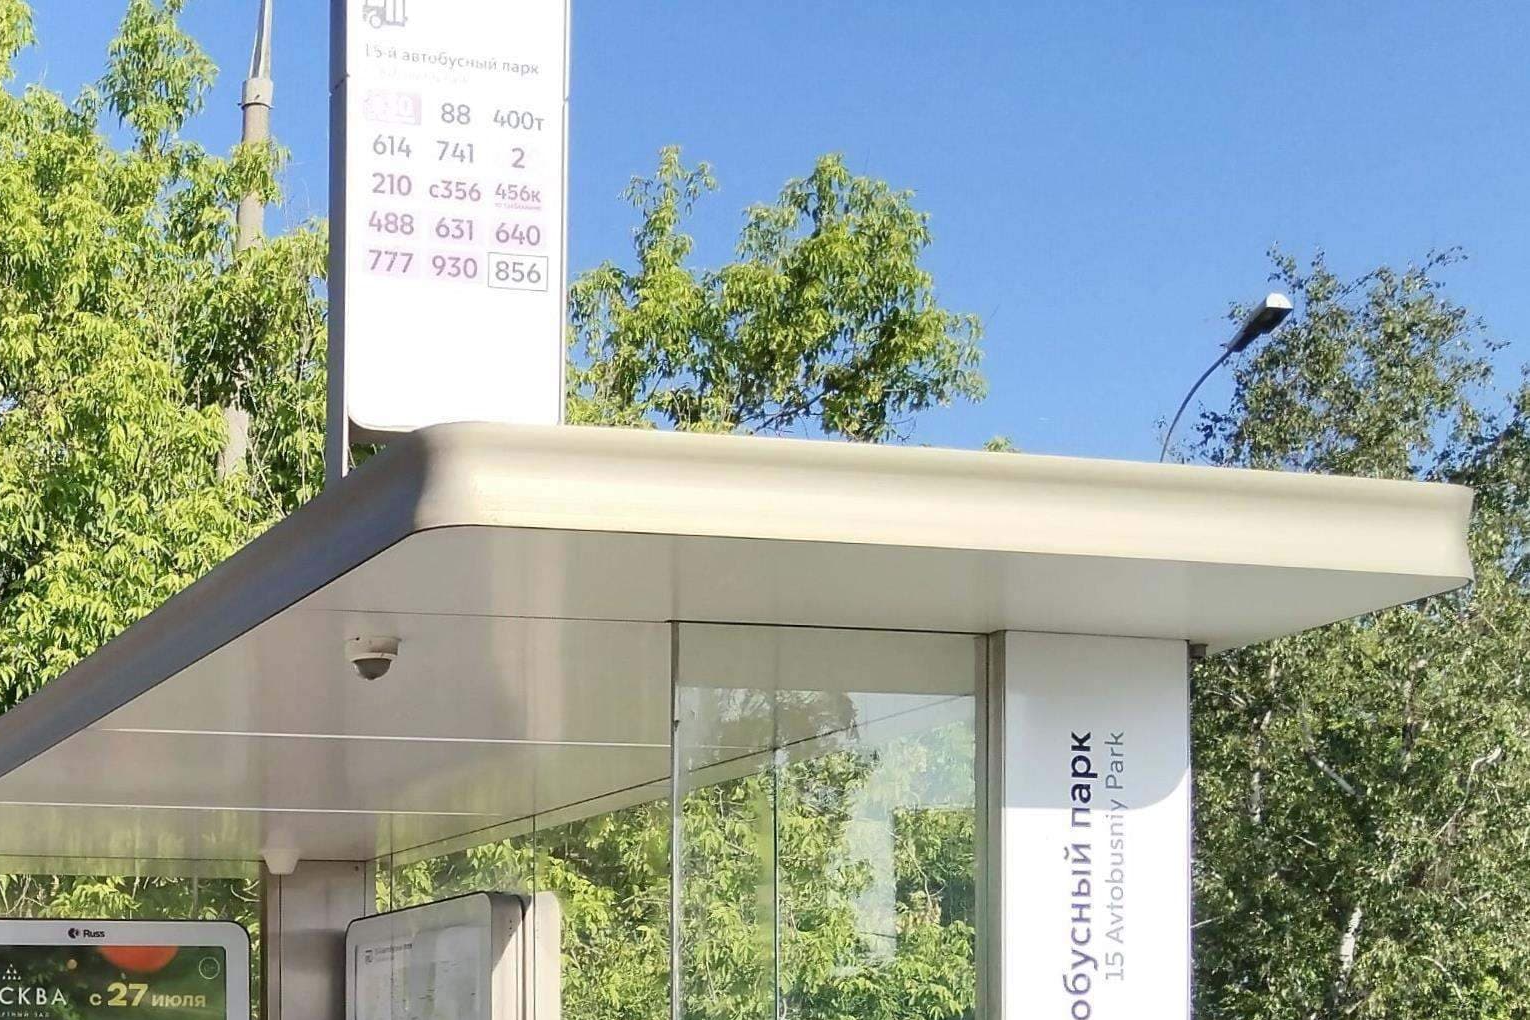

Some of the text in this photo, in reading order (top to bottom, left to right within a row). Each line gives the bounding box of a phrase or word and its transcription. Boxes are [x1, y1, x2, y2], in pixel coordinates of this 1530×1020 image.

[365, 43, 540, 78] 15-й автобусный парк
[440, 102, 471, 125] 88
[493, 109, 545, 132] 400т
[372, 134, 412, 158] 614
[436, 140, 474, 164] 741
[511, 147, 526, 169] 2
[371, 172, 412, 196] 210
[429, 180, 482, 202] с356
[494, 183, 542, 203] 456к
[368, 211, 415, 236] 488
[435, 217, 474, 241] 631
[495, 222, 541, 247] 640
[368, 249, 414, 274] 777
[431, 255, 478, 280] 930
[495, 261, 542, 284] 856
[1070, 730, 1098, 829] парк
[1104, 730, 1128, 983] 15 Avtobusniy Park
[83, 929, 106, 938] Russ
[107, 982, 149, 1007] 27
